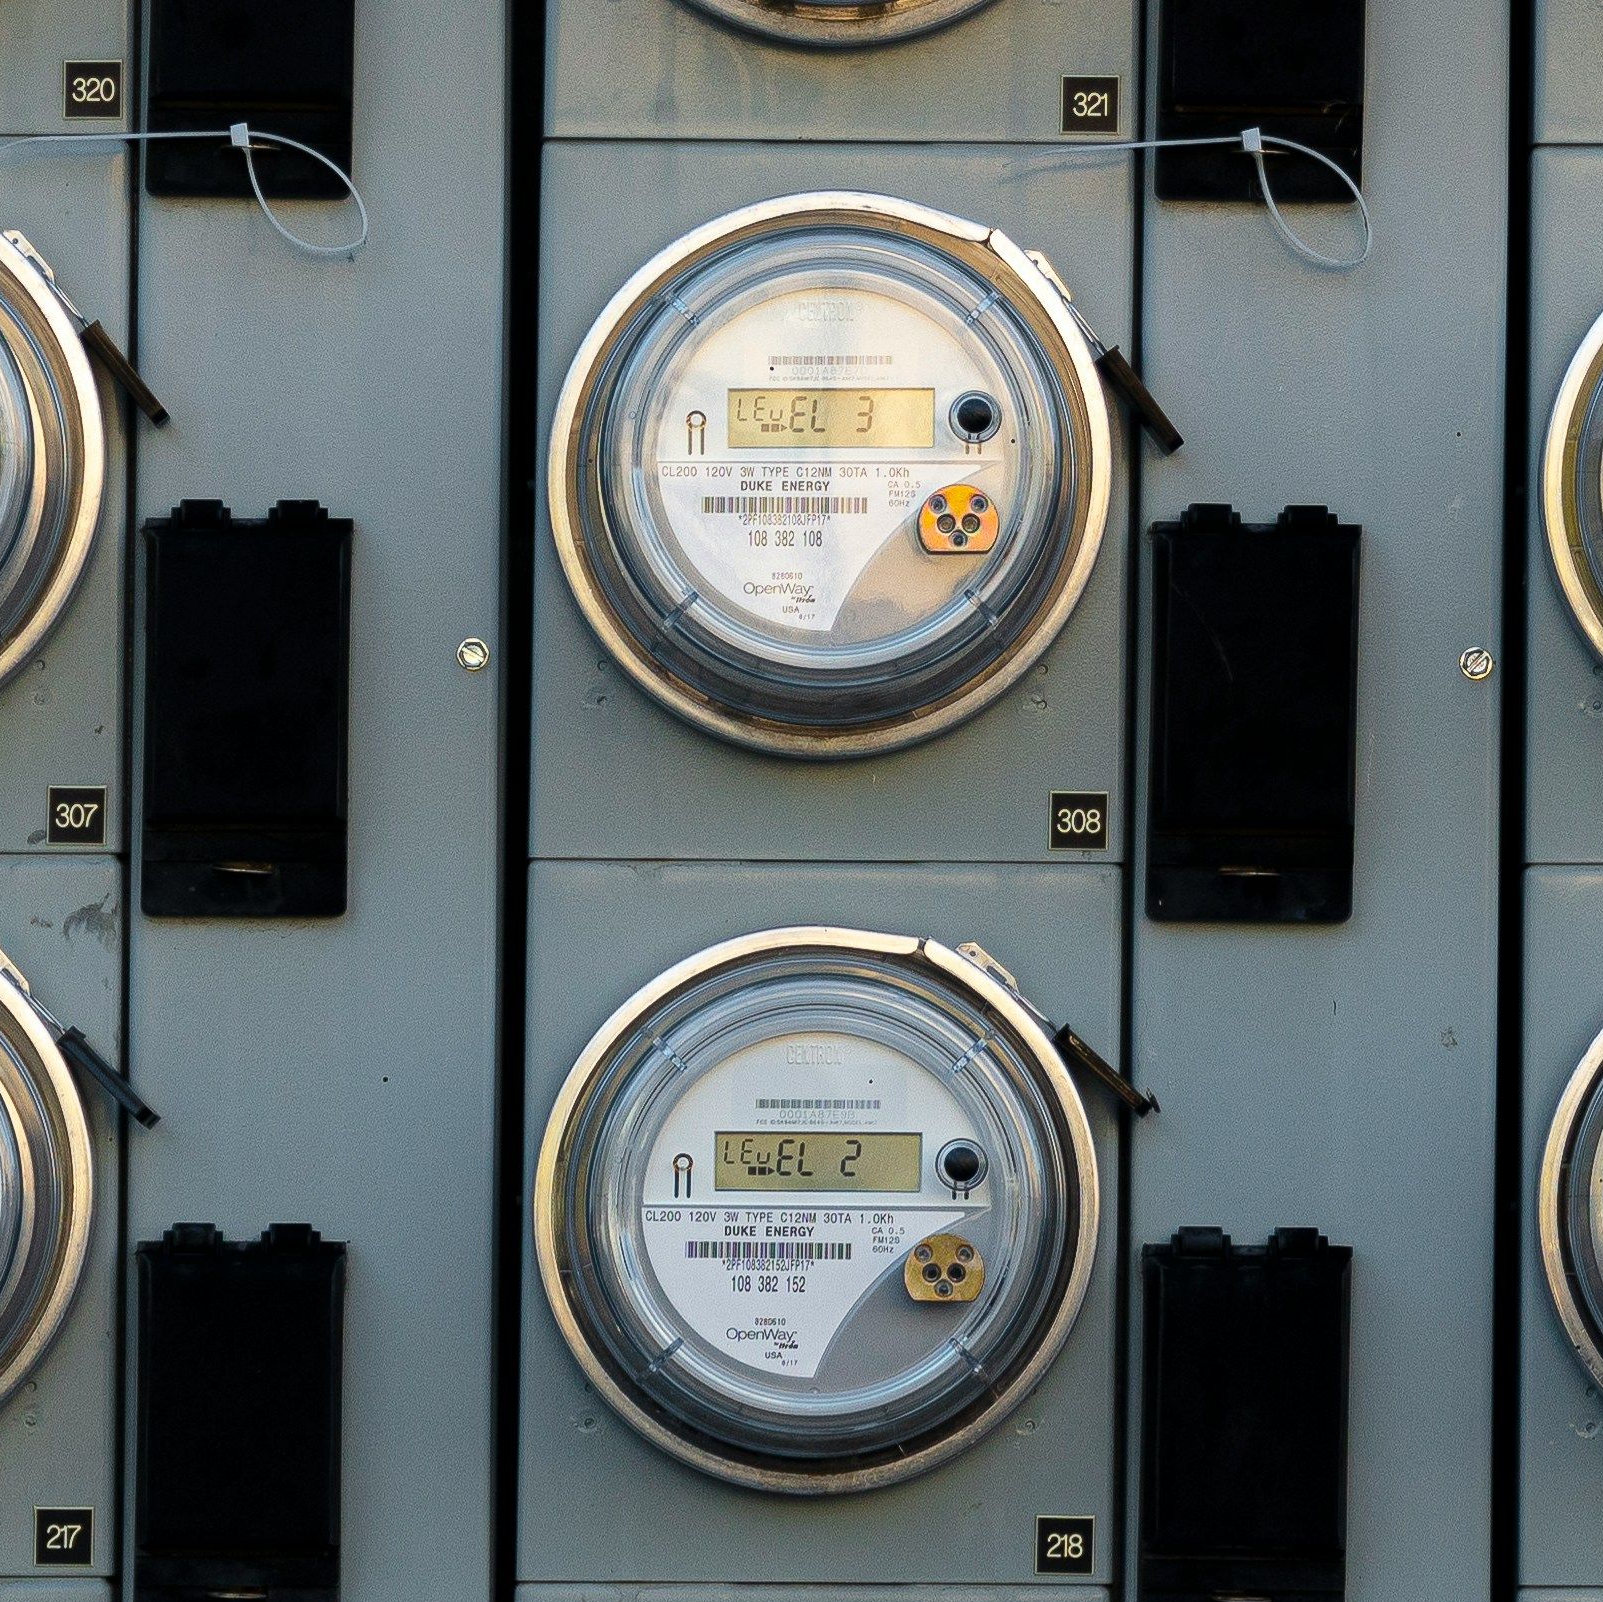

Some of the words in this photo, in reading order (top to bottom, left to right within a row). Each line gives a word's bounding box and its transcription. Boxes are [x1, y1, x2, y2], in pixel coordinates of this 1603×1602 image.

[72, 78, 115, 102] 320
[1073, 92, 1107, 116] 321
[740, 481, 773, 492] DUKE
[781, 481, 832, 492] ENERGY
[746, 531, 767, 547] 108
[773, 531, 794, 547] 382
[802, 531, 823, 547] 108
[56, 803, 98, 827] 307
[1057, 809, 1100, 833] 308
[724, 1226, 756, 1237] DUKE
[765, 1226, 815, 1237] ENERGY
[730, 1276, 751, 1293] 108
[757, 1277, 778, 1293] 382
[786, 1277, 806, 1293] 152
[47, 1525, 81, 1548] 217
[1047, 1534, 1082, 1558] 218
